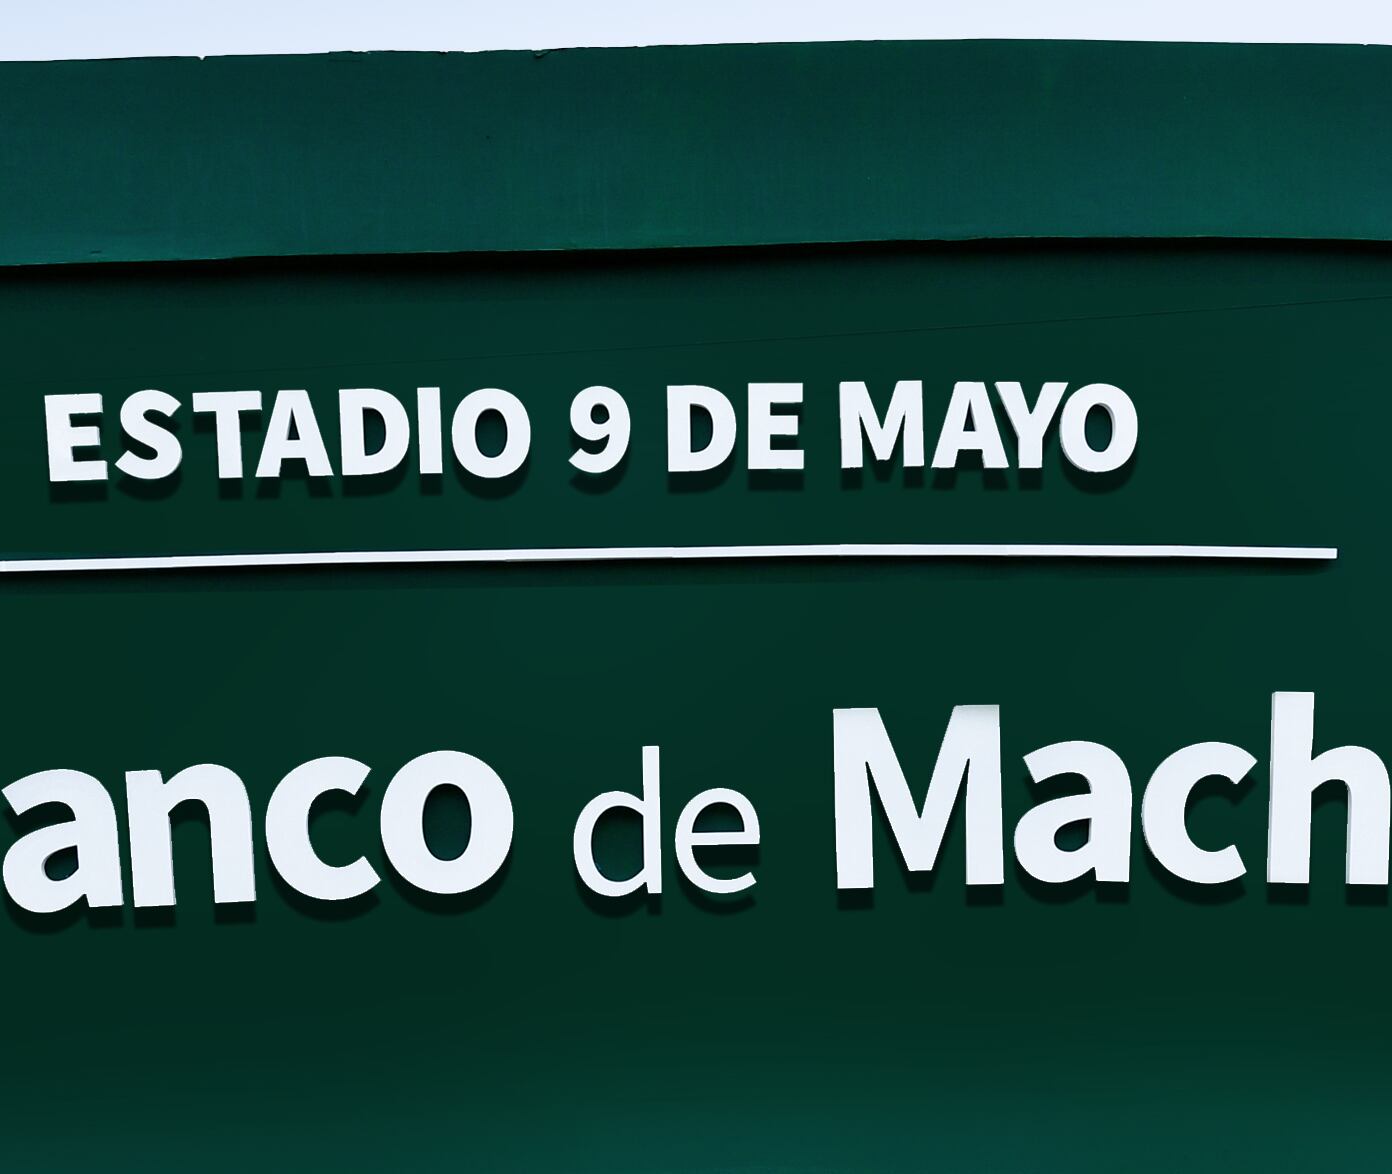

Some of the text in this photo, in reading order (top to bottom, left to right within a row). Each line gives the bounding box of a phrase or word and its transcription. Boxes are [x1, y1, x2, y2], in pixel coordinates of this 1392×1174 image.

[43, 379, 1139, 482] ESTADIO 9 DE MAYO
[573, 745, 761, 897] de
